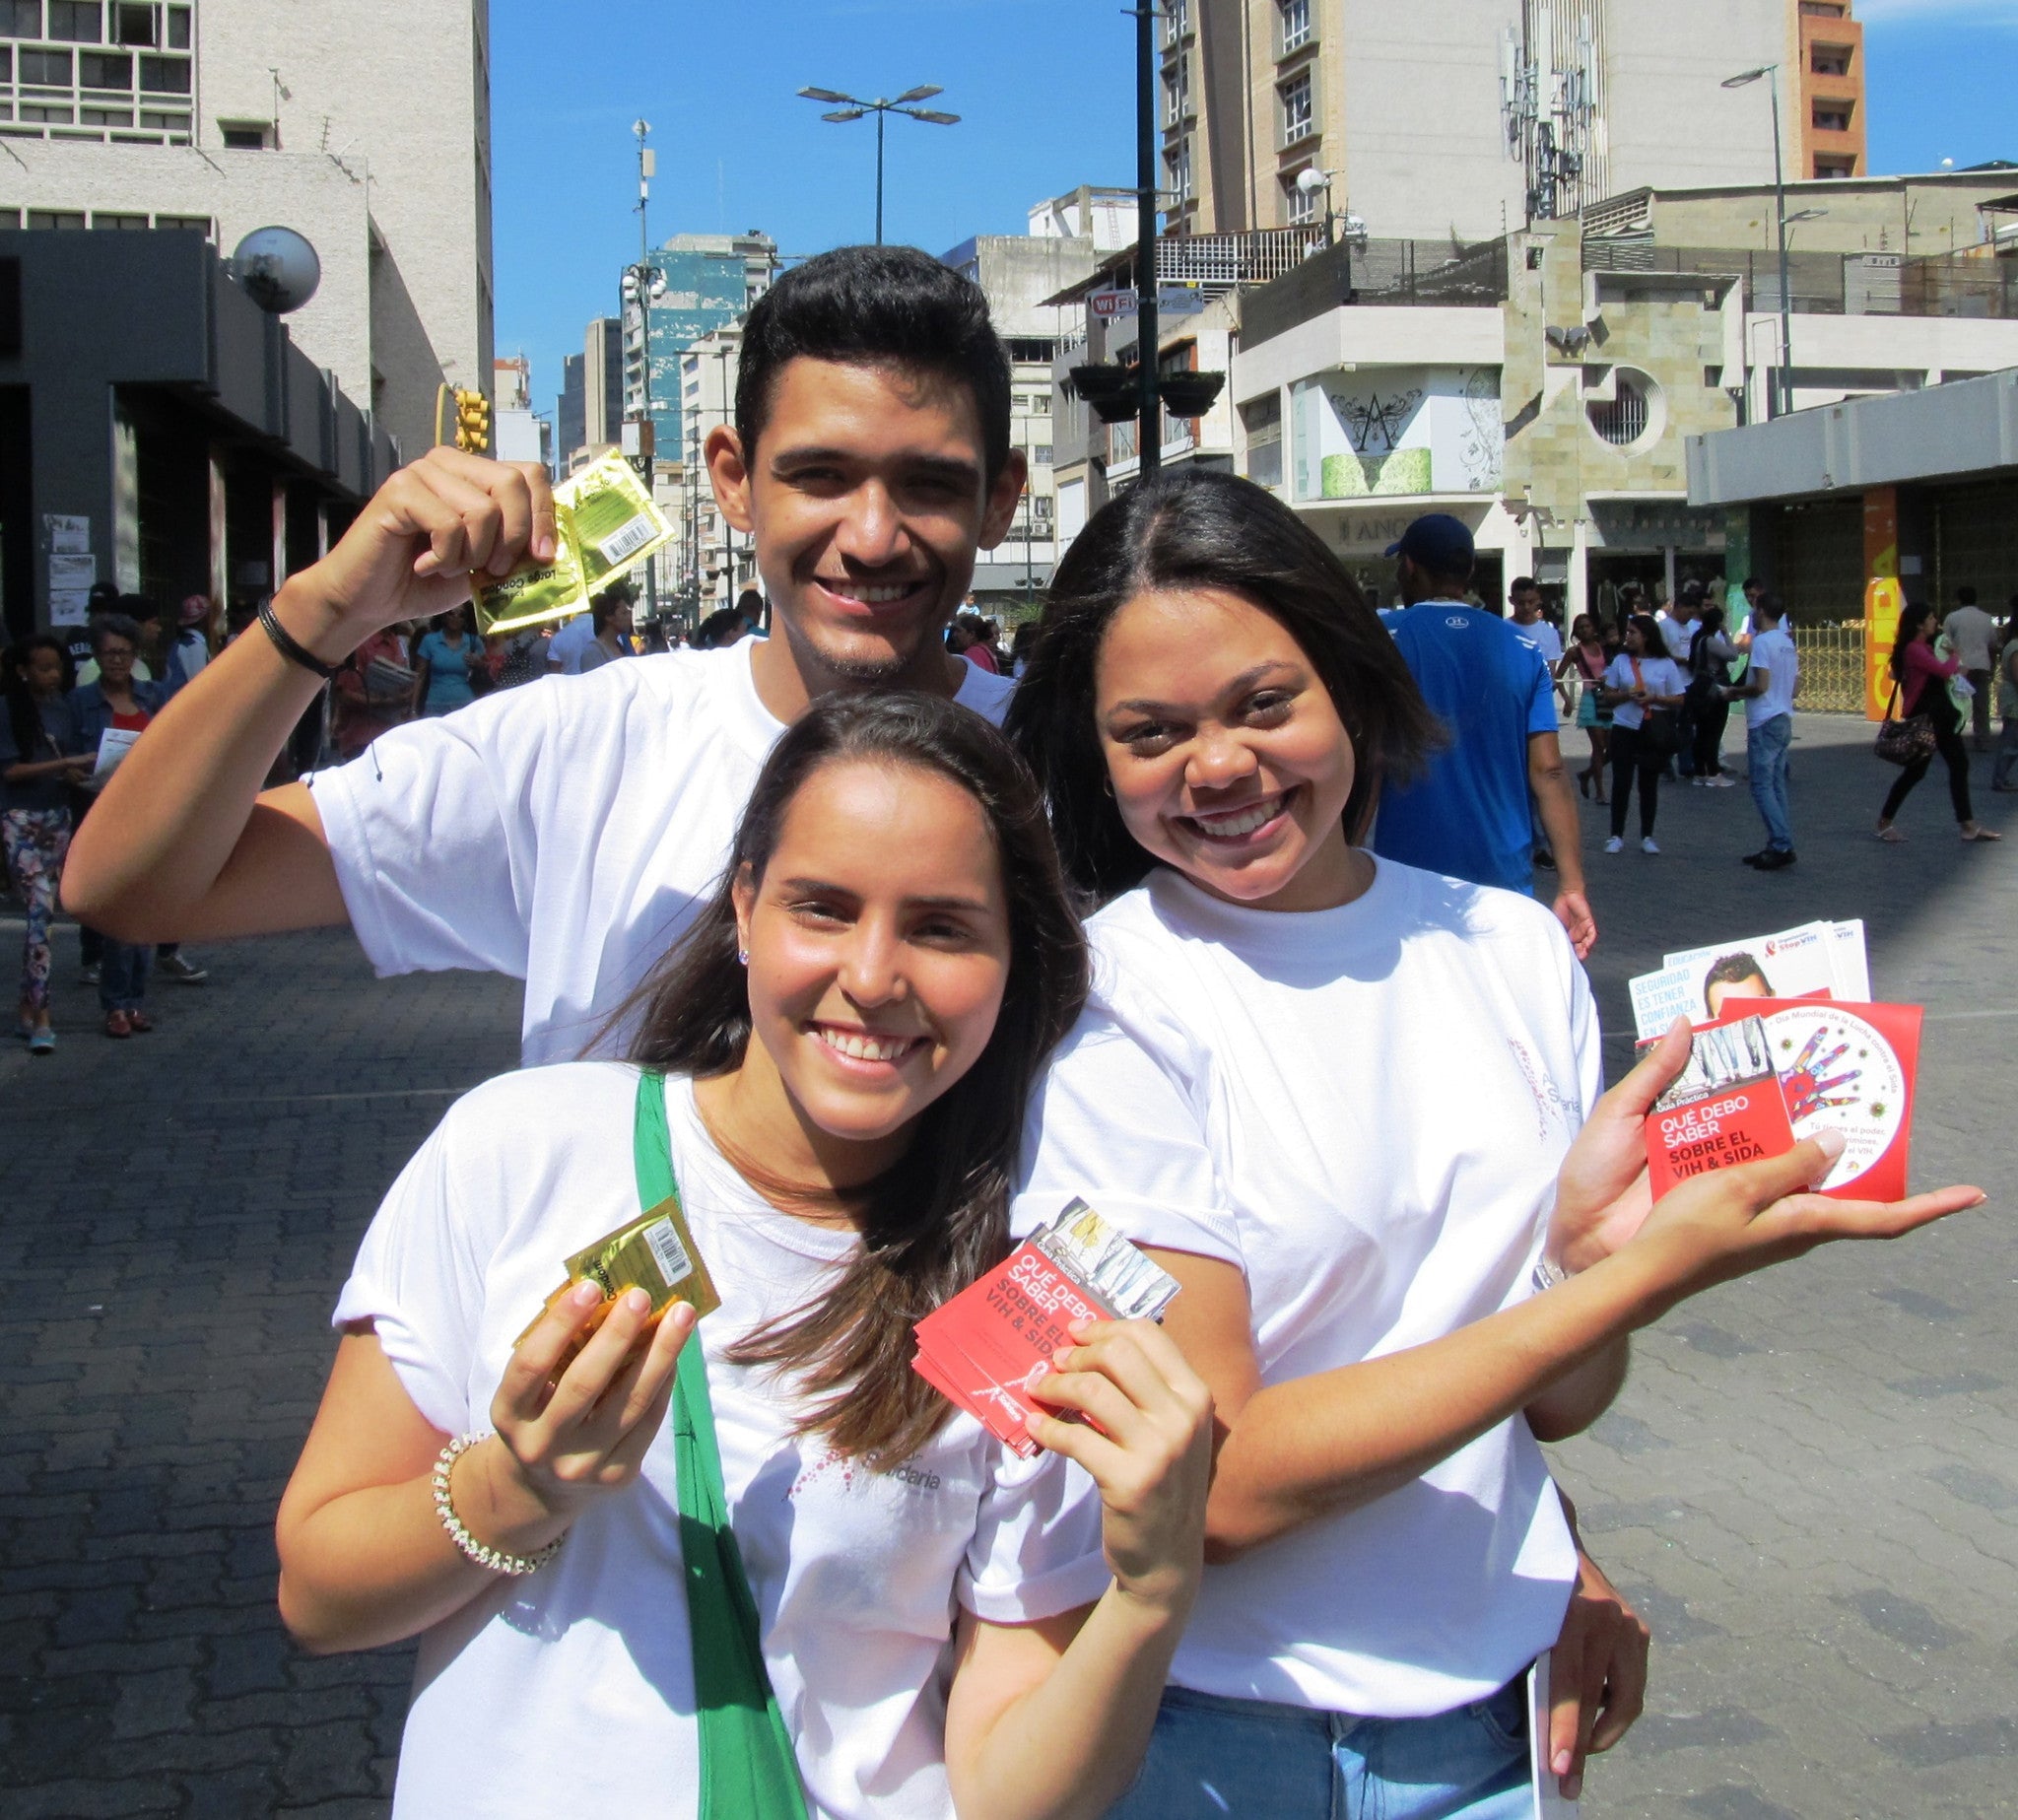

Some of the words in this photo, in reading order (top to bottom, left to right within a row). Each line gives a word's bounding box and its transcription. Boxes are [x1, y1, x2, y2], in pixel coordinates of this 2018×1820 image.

[1636, 969, 1690, 995] SEGURIDAD
[1639, 996, 1651, 1011] ES
[1652, 985, 1685, 1005] TENER
[1641, 998, 1697, 1026] CONFIANZA
[1791, 1009, 1827, 1019] Mundial
[1829, 1011, 1840, 1021] de
[1850, 1019, 1872, 1040] Lucha
[1871, 1038, 1892, 1064] contra
[1889, 1073, 1898, 1094] Sida
[1660, 1108, 1699, 1134] QUÉ
[1700, 1096, 1749, 1121] DEBO
[1663, 1119, 1720, 1149] SABER
[1669, 1136, 1726, 1164] SOBRE
[1729, 1130, 1751, 1147] EL
[1672, 1162, 1704, 1179] VIH
[1708, 1156, 1720, 1171] &
[1723, 1142, 1765, 1166] SIDA
[594, 1259, 618, 1302] Condom
[1008, 1264, 1059, 1315] SABER
[1021, 1254, 1057, 1289] QUÉ
[986, 1288, 1014, 1318] VIH
[1012, 1315, 1025, 1332] &
[997, 1278, 1048, 1327] SOBRE
[1046, 1324, 1064, 1347] EL
